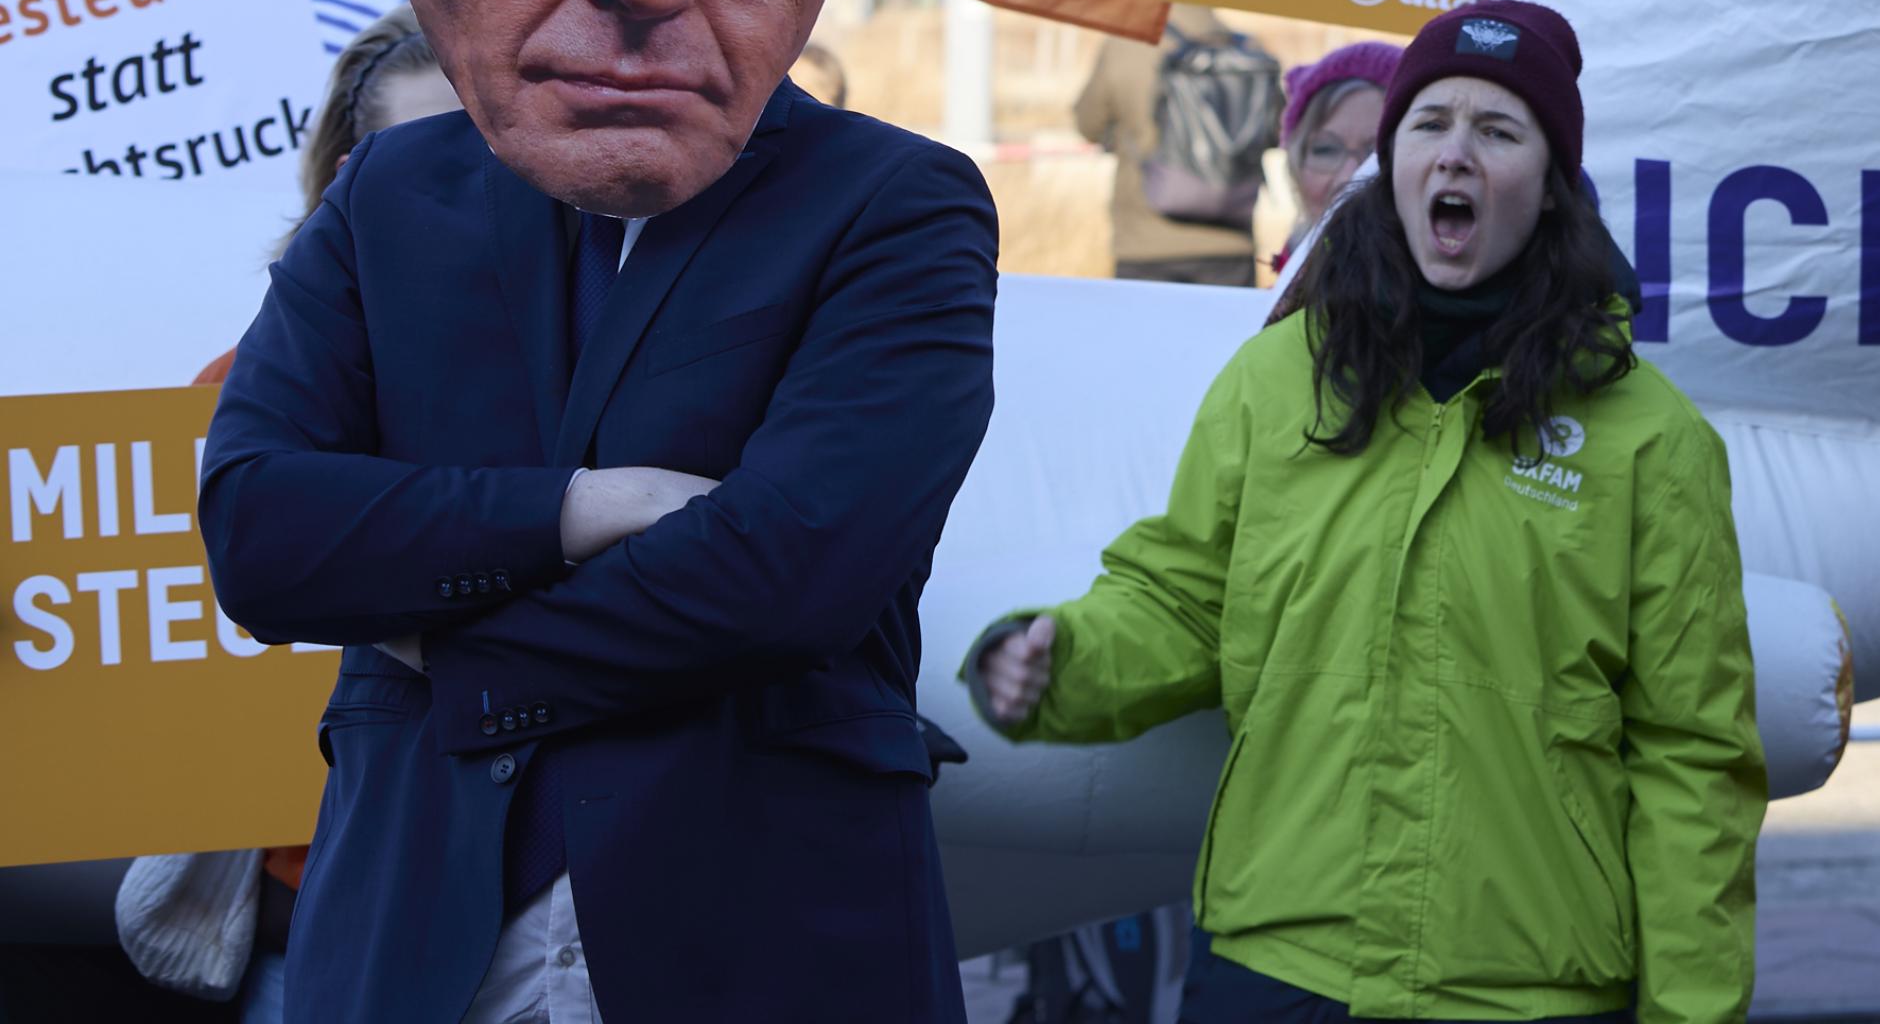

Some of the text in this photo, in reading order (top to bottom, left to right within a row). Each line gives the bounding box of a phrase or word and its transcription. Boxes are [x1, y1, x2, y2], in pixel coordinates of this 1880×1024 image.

[49, 32, 204, 121] statt
[8, 437, 206, 542] MIL
[1503, 475, 1579, 512] Deutschland
